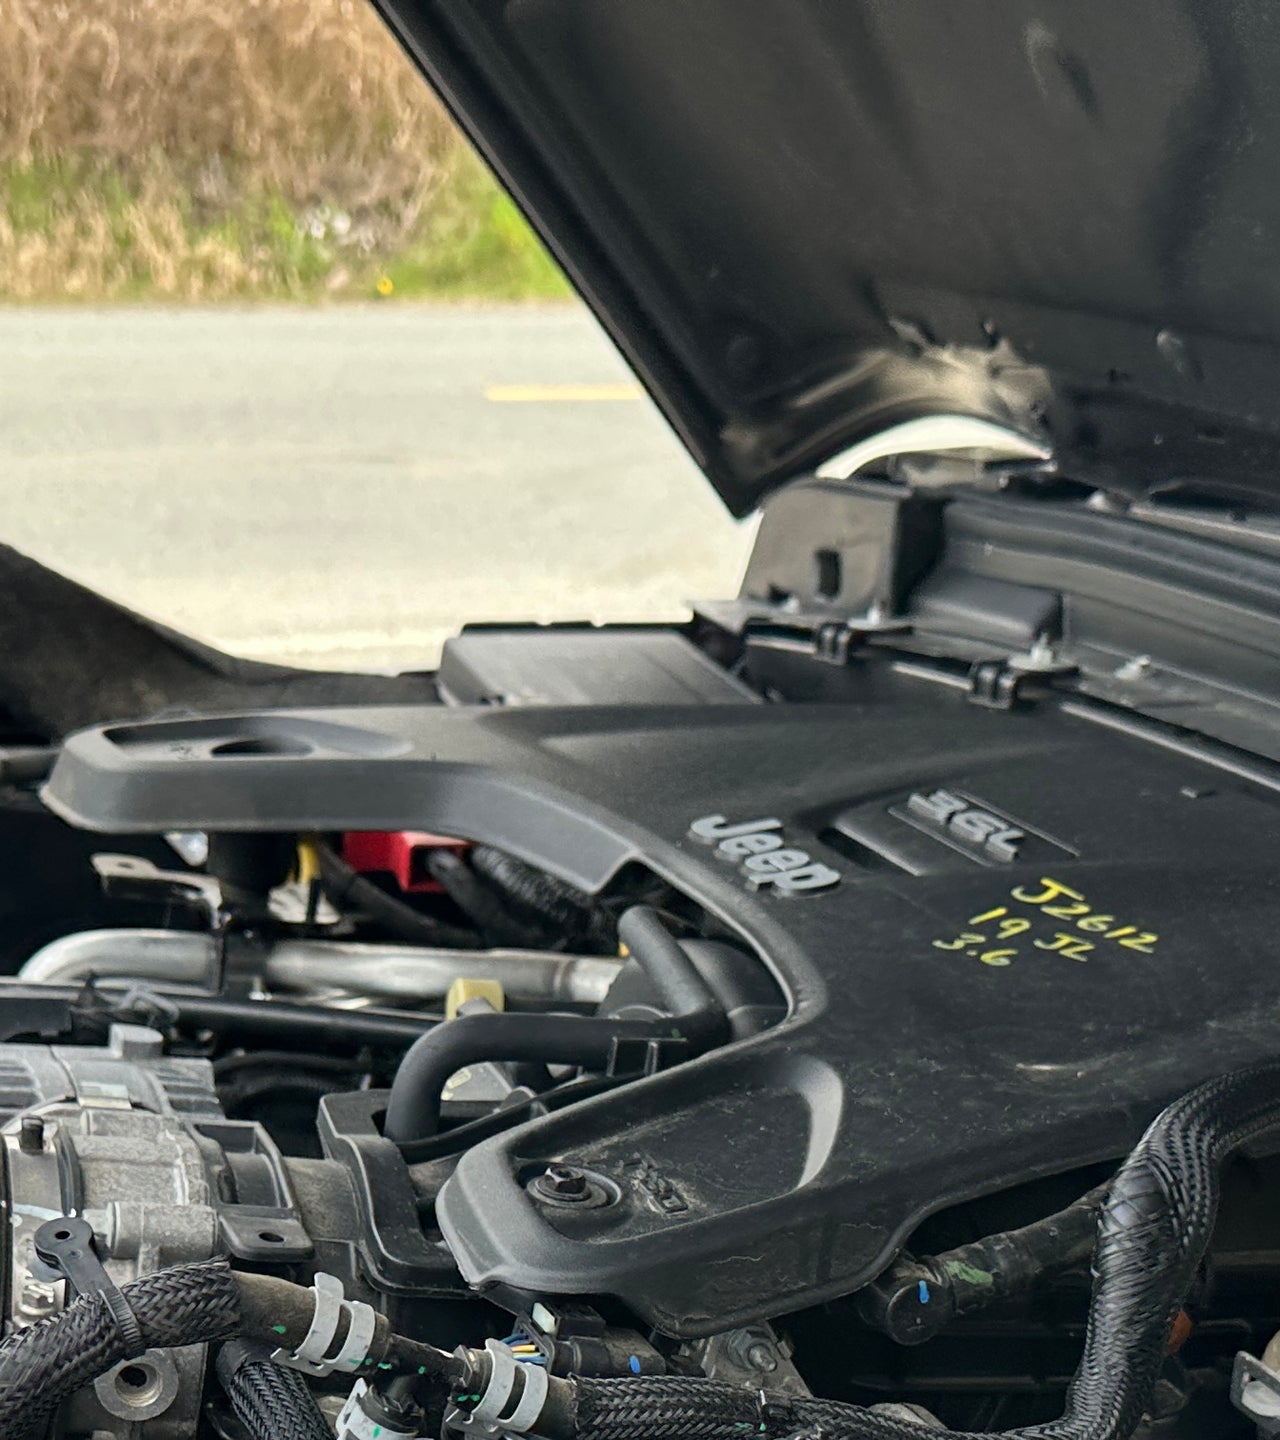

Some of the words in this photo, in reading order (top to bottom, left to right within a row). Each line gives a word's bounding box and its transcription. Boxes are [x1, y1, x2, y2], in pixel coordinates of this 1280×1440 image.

[689, 814, 842, 893] Jeep
[968, 906, 1032, 940] 19
[1033, 932, 1096, 963] JL
[1010, 876, 1160, 954] J2612
[931, 933, 1019, 967] 3.6
